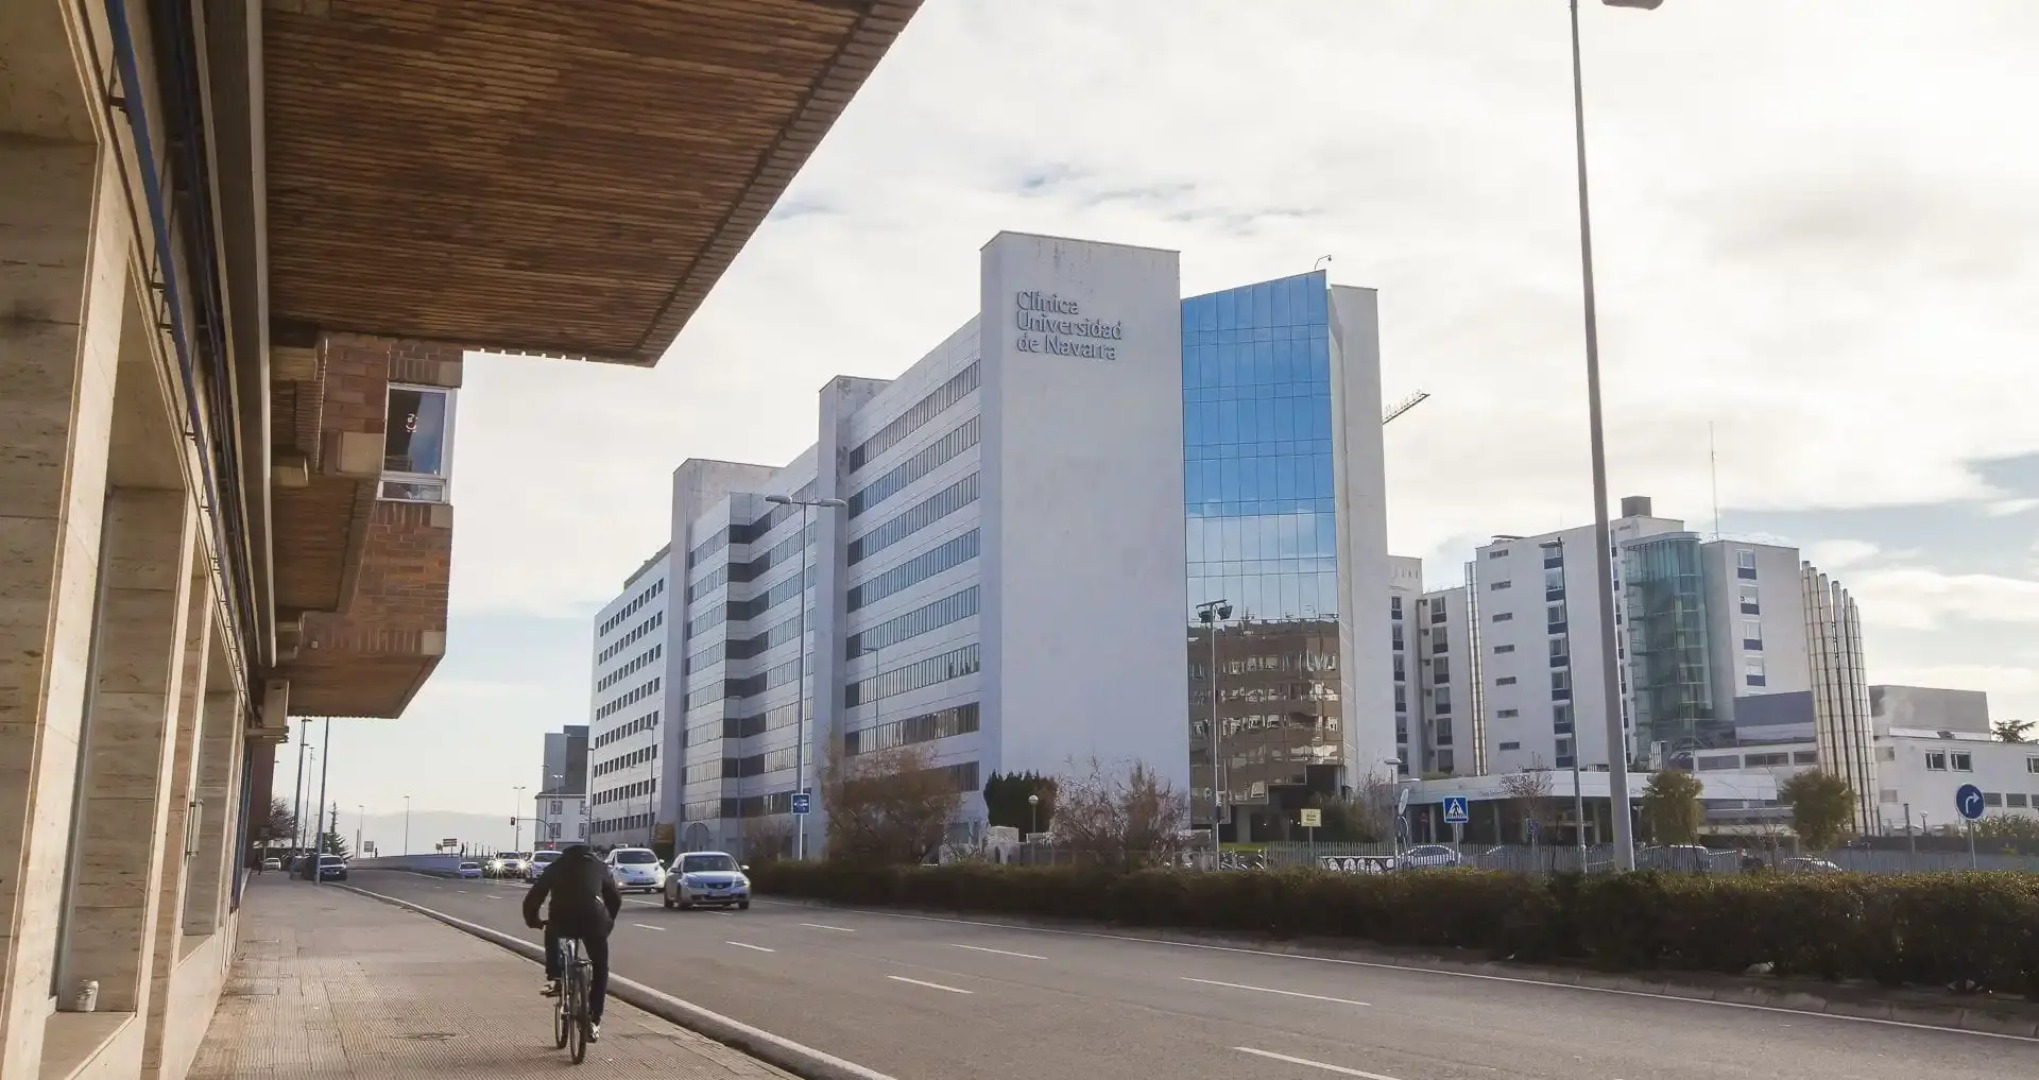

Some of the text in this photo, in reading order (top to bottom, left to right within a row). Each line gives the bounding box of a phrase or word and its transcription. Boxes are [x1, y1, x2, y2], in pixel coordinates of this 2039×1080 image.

[1016, 310, 1122, 340] Universidad
[1016, 332, 1116, 360] de Navarra
